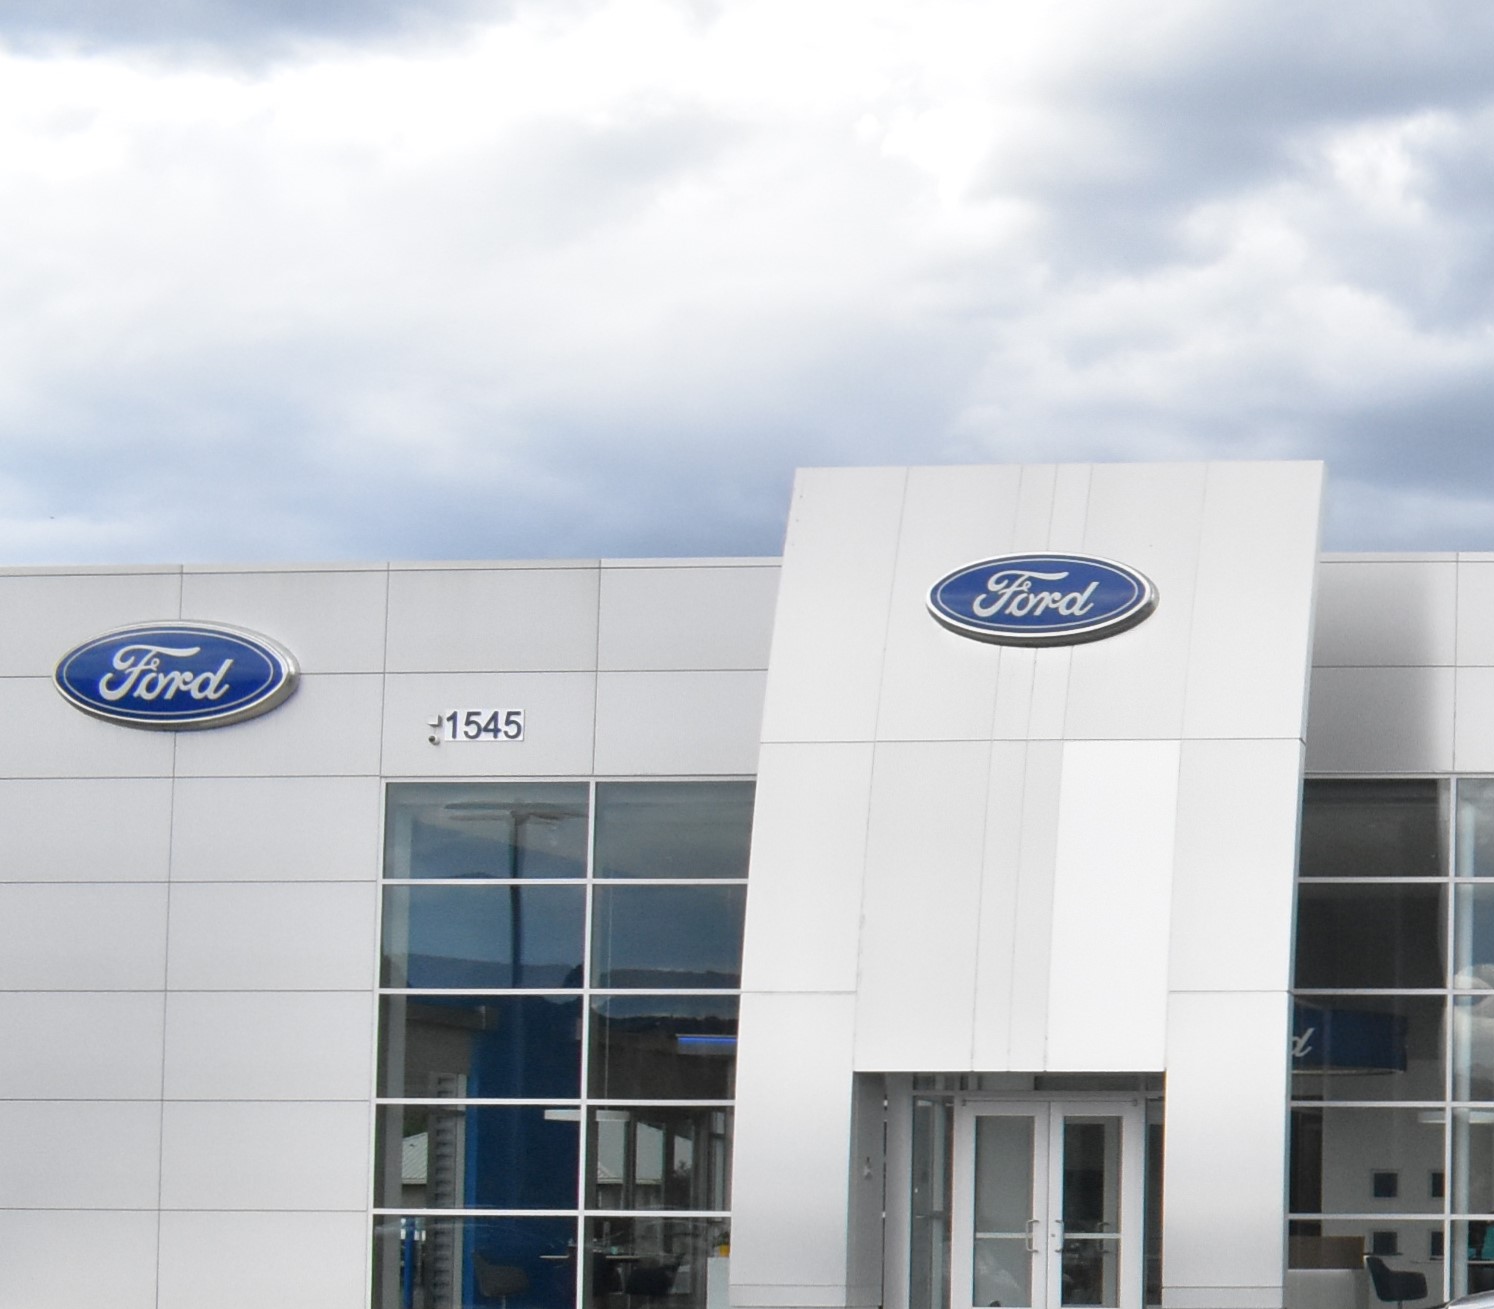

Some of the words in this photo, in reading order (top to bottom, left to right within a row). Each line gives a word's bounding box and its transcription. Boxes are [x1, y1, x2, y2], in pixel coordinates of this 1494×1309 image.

[973, 570, 1100, 617] Ford
[99, 644, 233, 700] Ford
[445, 710, 523, 740] 1545
